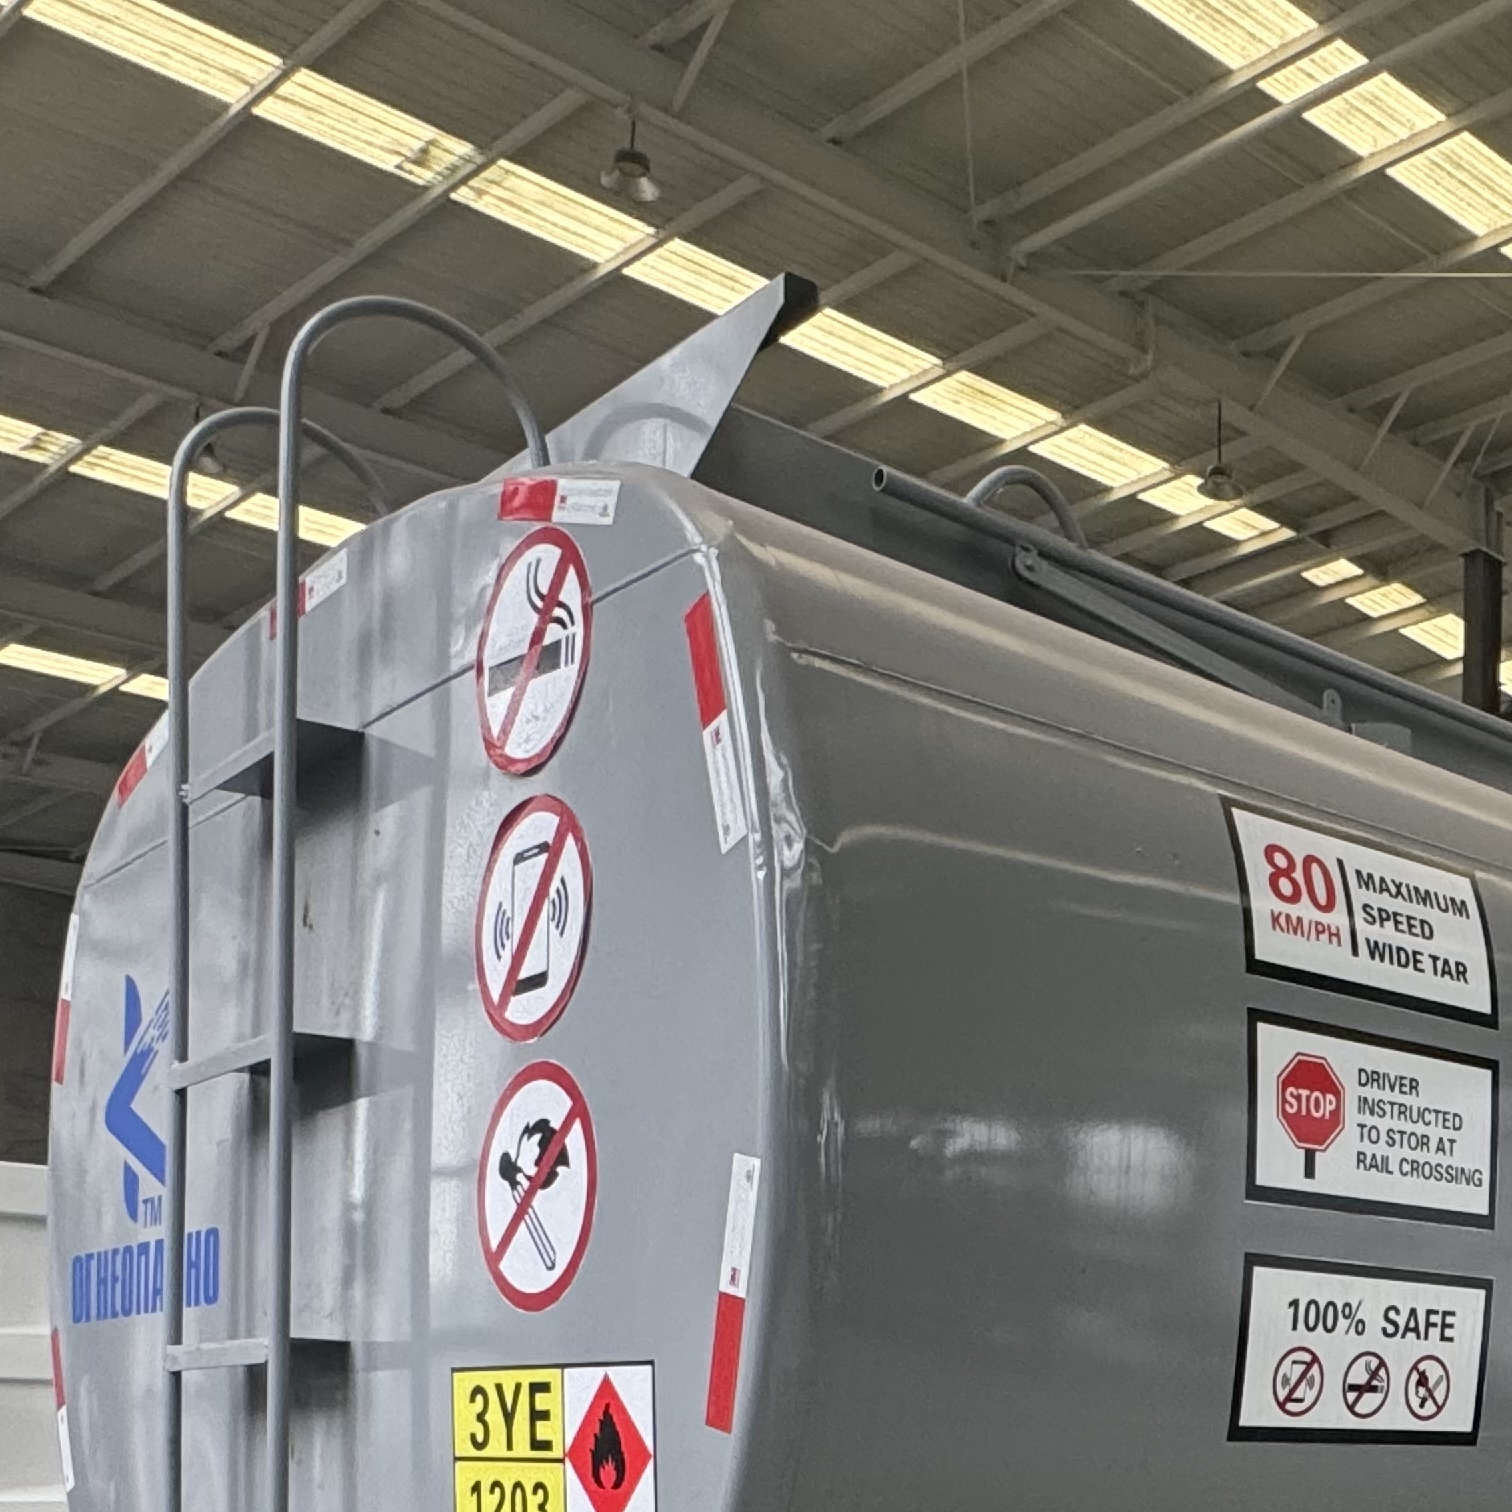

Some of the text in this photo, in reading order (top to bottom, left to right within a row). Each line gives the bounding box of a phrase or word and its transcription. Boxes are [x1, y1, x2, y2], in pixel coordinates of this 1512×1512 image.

[1264, 844, 1337, 914] 80
[1355, 868, 1470, 920] MAXIMUM
[1270, 909, 1342, 947] KM/PH
[1362, 903, 1434, 941] SPEED
[1365, 937, 1469, 985] WIDE TAR
[1357, 1068, 1420, 1097] DRIVER
[1285, 1086, 1337, 1120] STOP
[1356, 1095, 1463, 1131] INSTRUCTED
[1356, 1123, 1457, 1157] TO STOR AT
[1356, 1151, 1483, 1187] RAIL CROSSING
[142, 1195, 162, 1227] TM
[72, 1227, 220, 1324] ОГНЕОПАНО
[1287, 1298, 1456, 1343] 100% SAFE
[469, 1381, 553, 1451] 3YE
